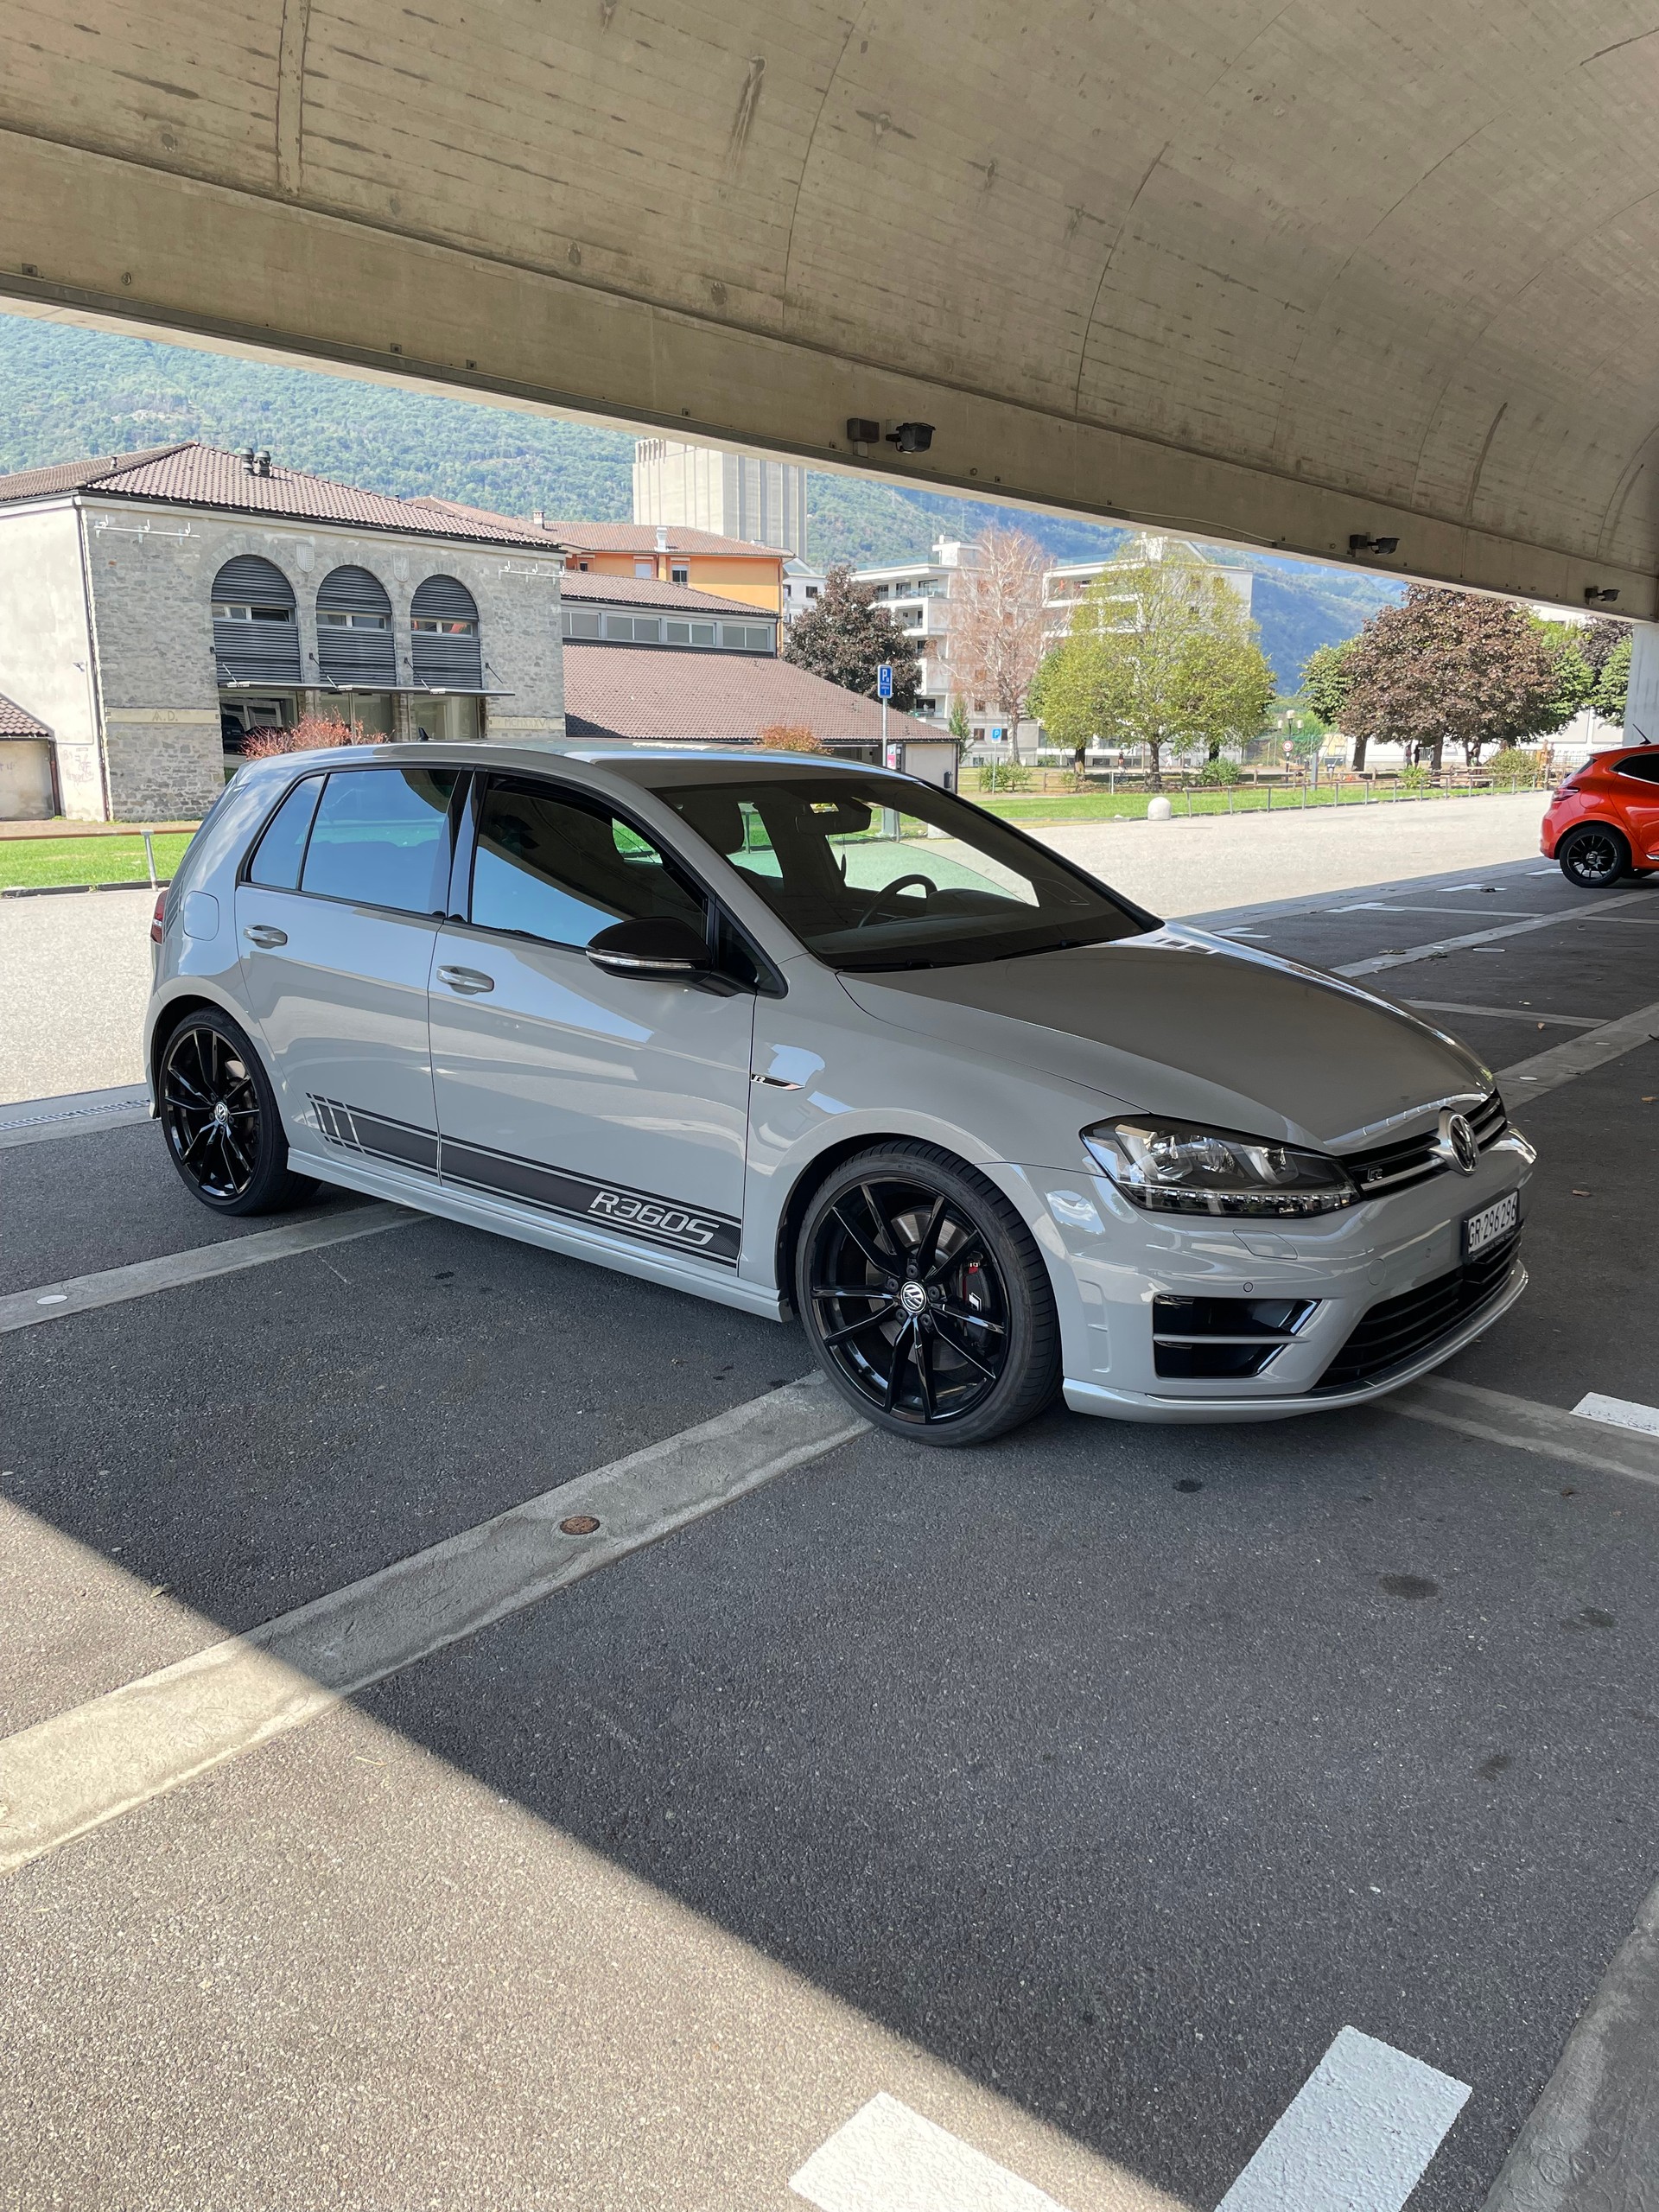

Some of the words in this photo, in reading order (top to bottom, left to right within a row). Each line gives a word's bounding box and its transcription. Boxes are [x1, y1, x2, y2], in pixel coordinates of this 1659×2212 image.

[882, 669, 887, 681] P
[751, 1075, 766, 1084] R
[1367, 1167, 1382, 1182] R
[588, 1191, 720, 1245] R360S
